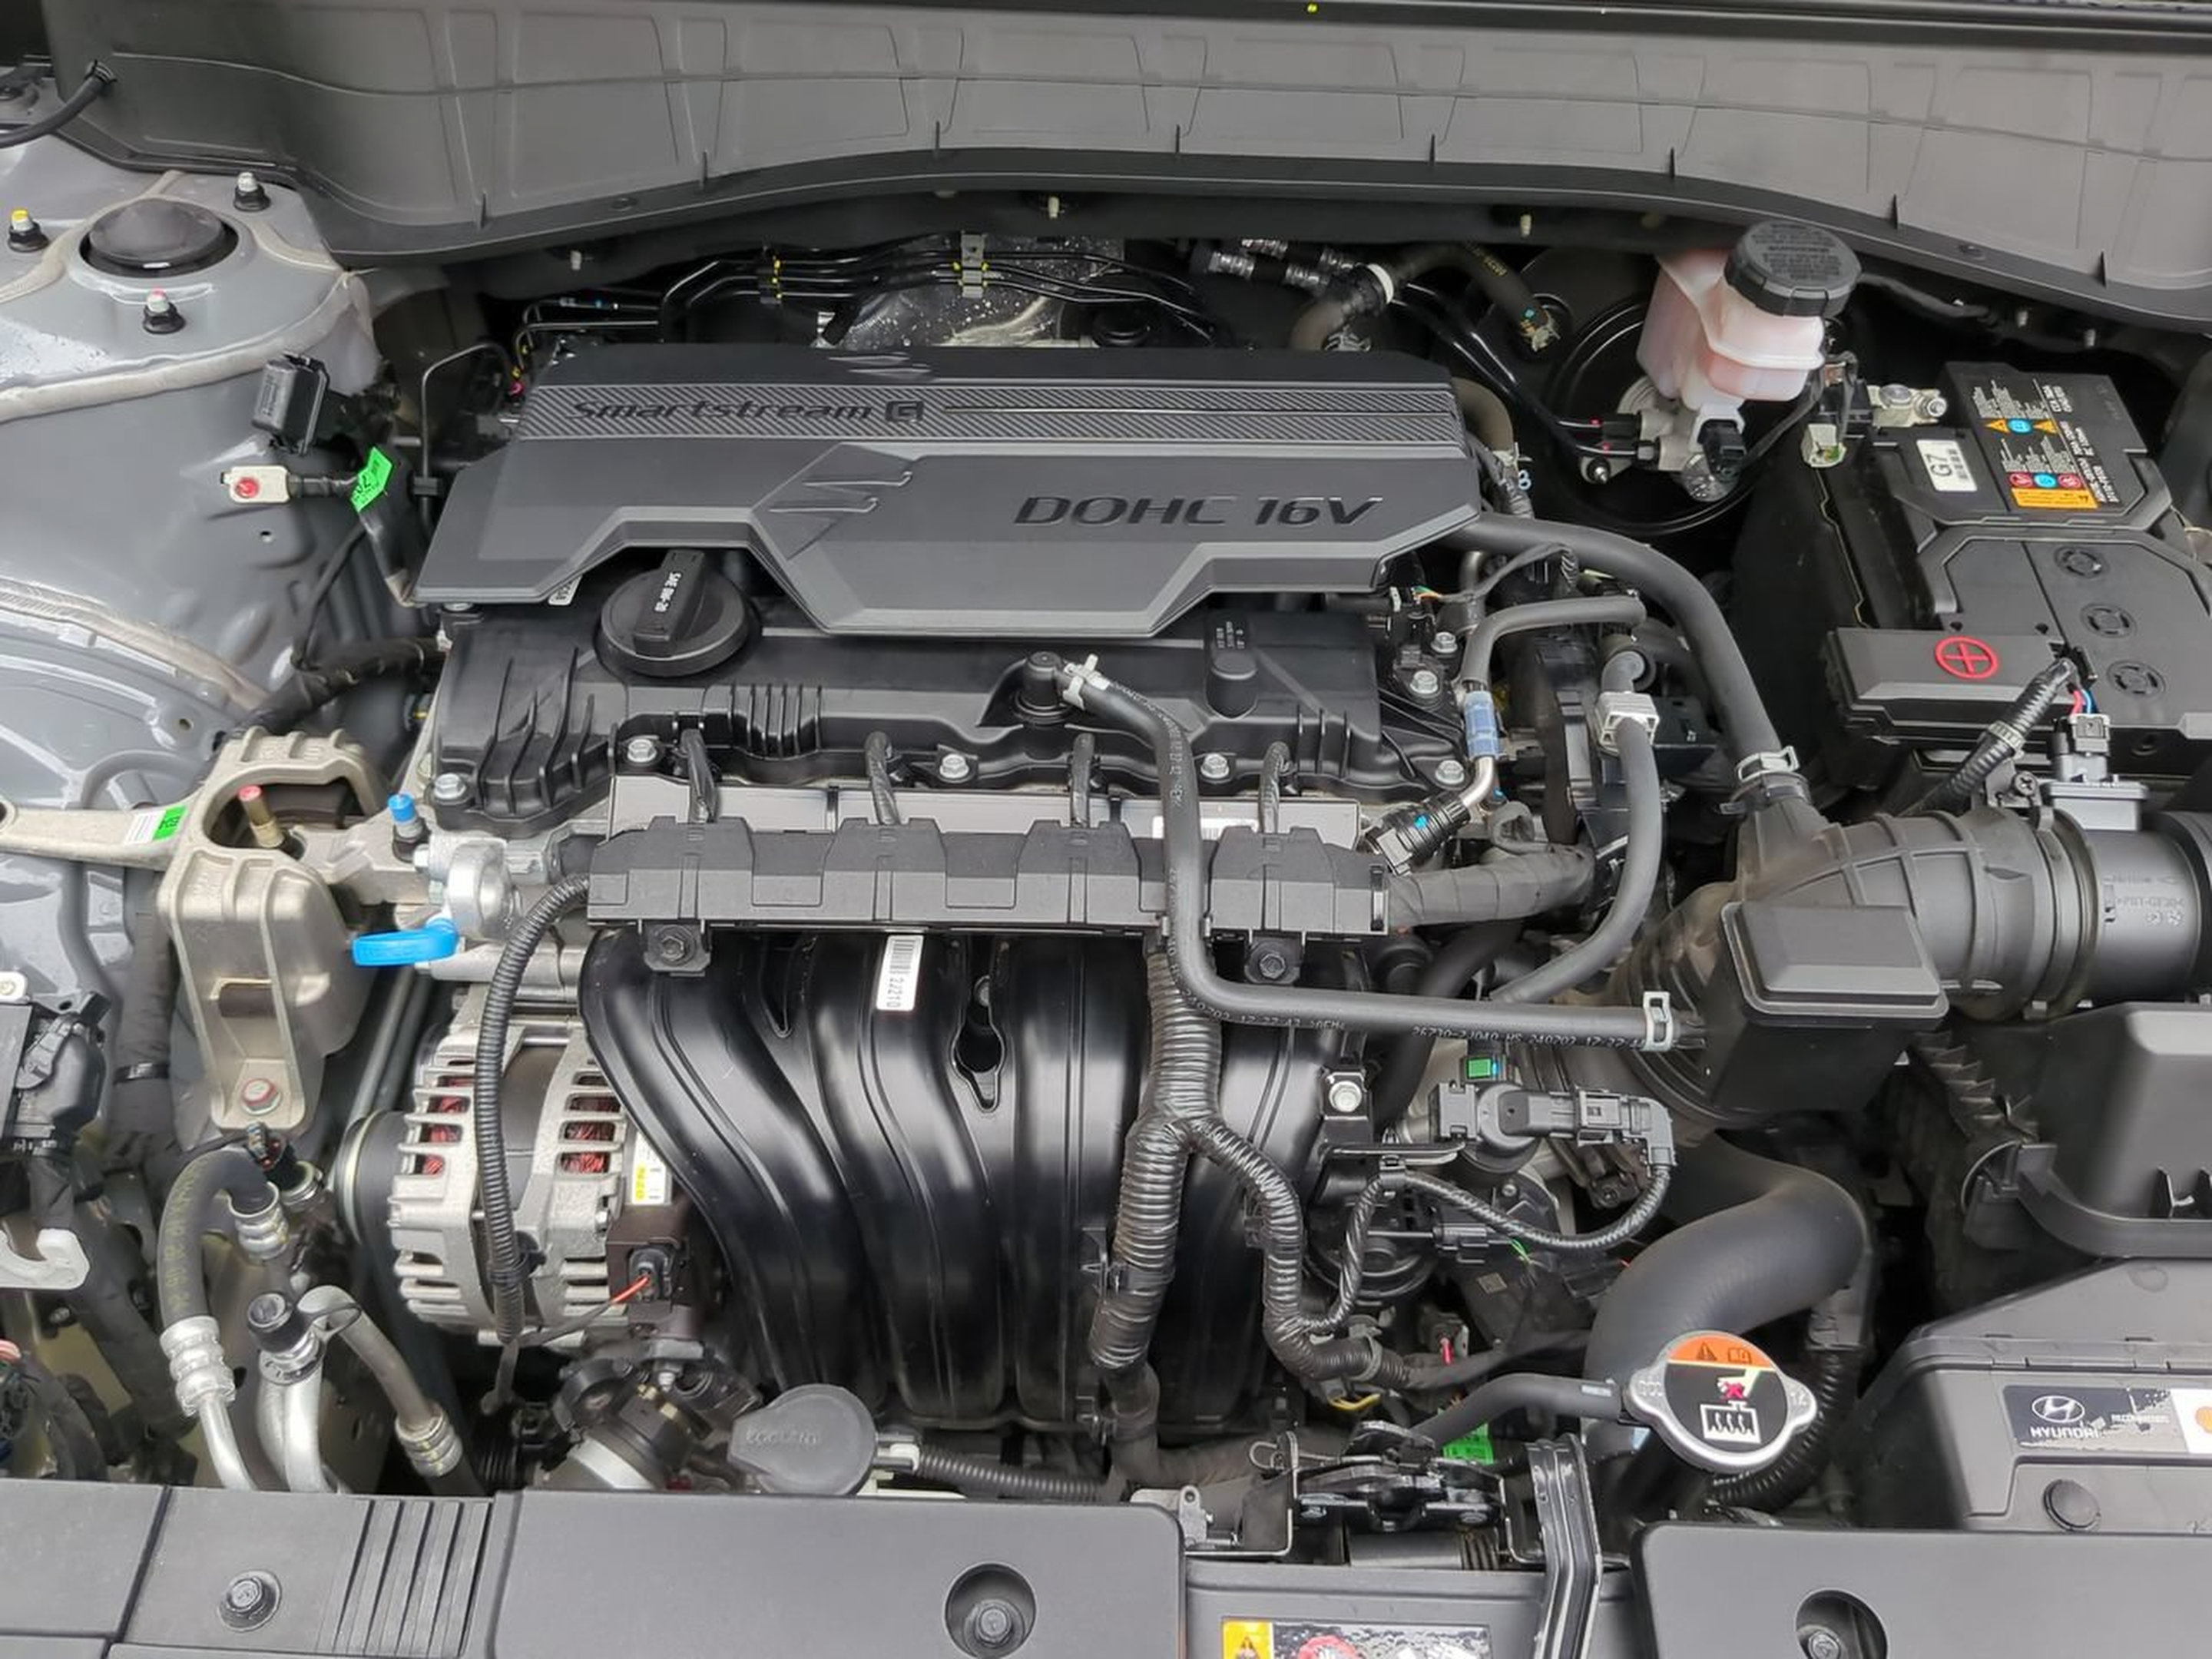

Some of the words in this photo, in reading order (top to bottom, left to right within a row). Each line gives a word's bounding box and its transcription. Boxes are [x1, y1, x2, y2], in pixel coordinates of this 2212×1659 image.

[566, 399, 872, 419] Smartstream
[1924, 453, 1952, 477] G7
[1013, 495, 1237, 526] DOHC
[1255, 495, 1383, 526] 16V
